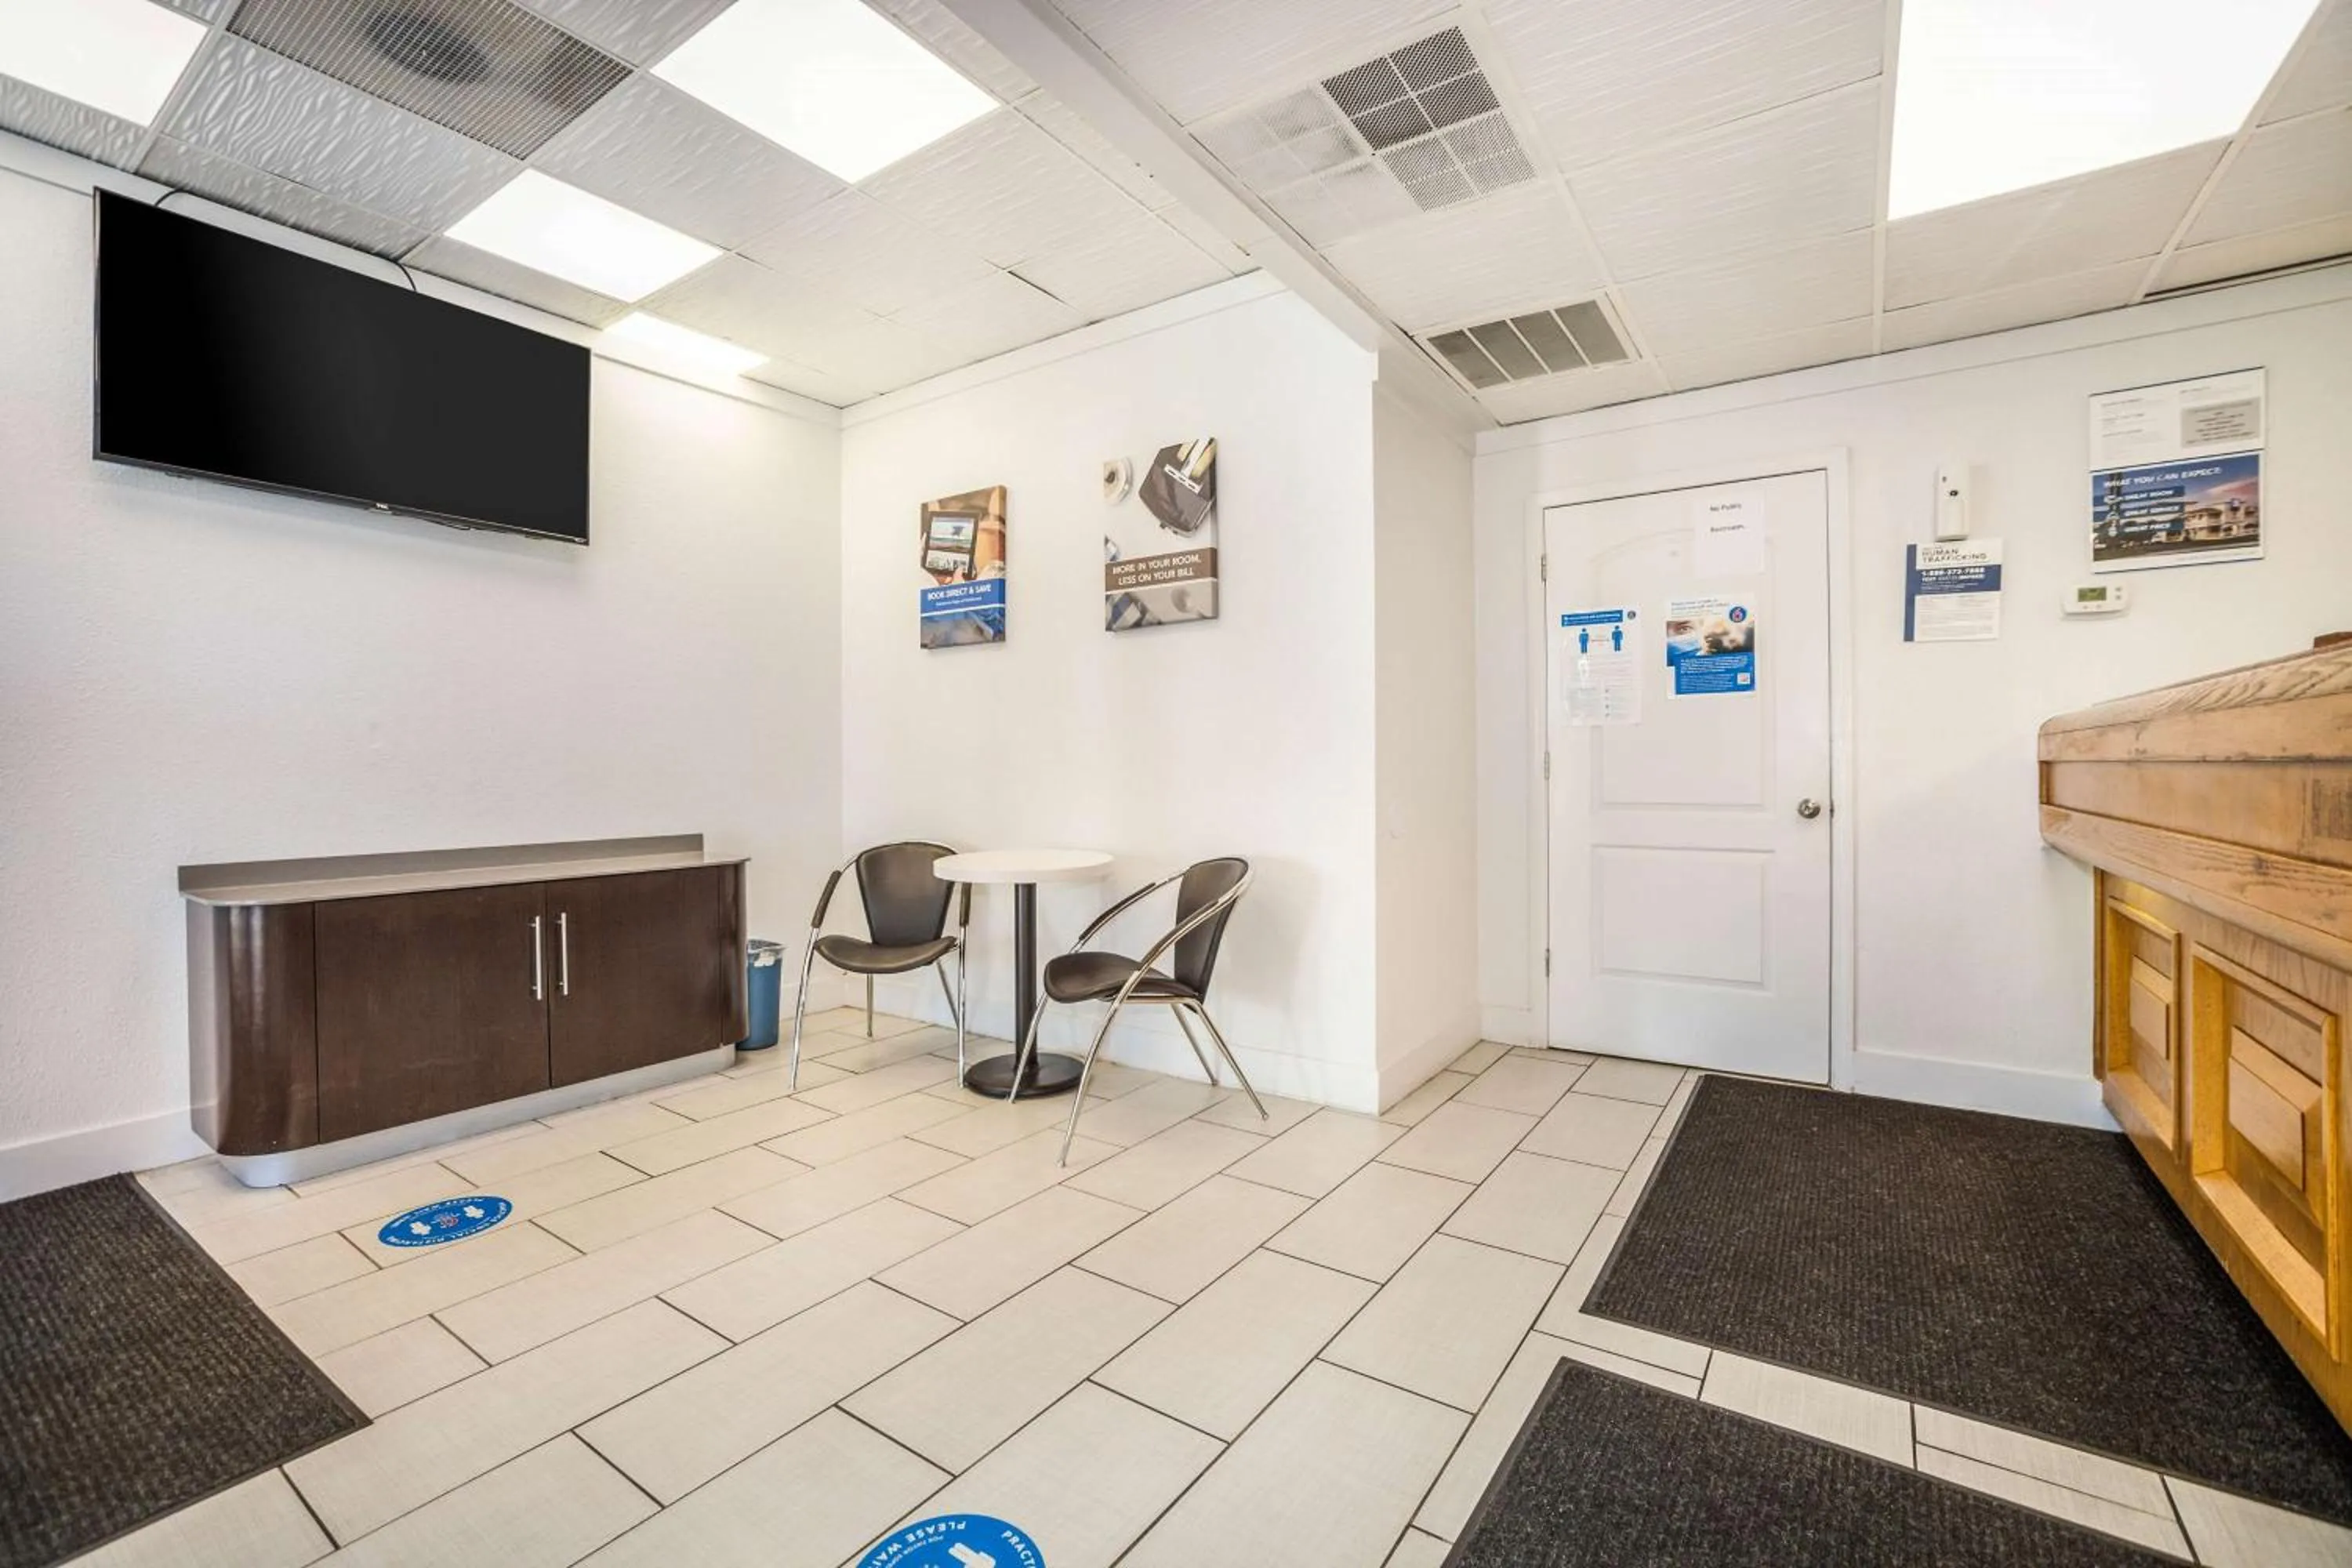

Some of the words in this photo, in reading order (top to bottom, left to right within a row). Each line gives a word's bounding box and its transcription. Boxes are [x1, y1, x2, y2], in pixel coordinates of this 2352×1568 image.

[2156, 473, 2179, 481] CAN
[1112, 564, 1135, 574] MORE
[1149, 558, 1171, 568] YOUR
[1922, 553, 1987, 563] TRAFFICKING
[1118, 575, 1136, 586] LESS
[1138, 573, 1152, 583] ON
[1153, 570, 1175, 580] YOUR
[1177, 567, 1193, 578] BILL
[927, 591, 945, 601] BOOK
[946, 587, 968, 597] DIRECT
[969, 586, 975, 595] &
[975, 583, 992, 593] SAVE
[905, 1521, 967, 1543] PLEASE
[867, 1542, 902, 1568] WAI
